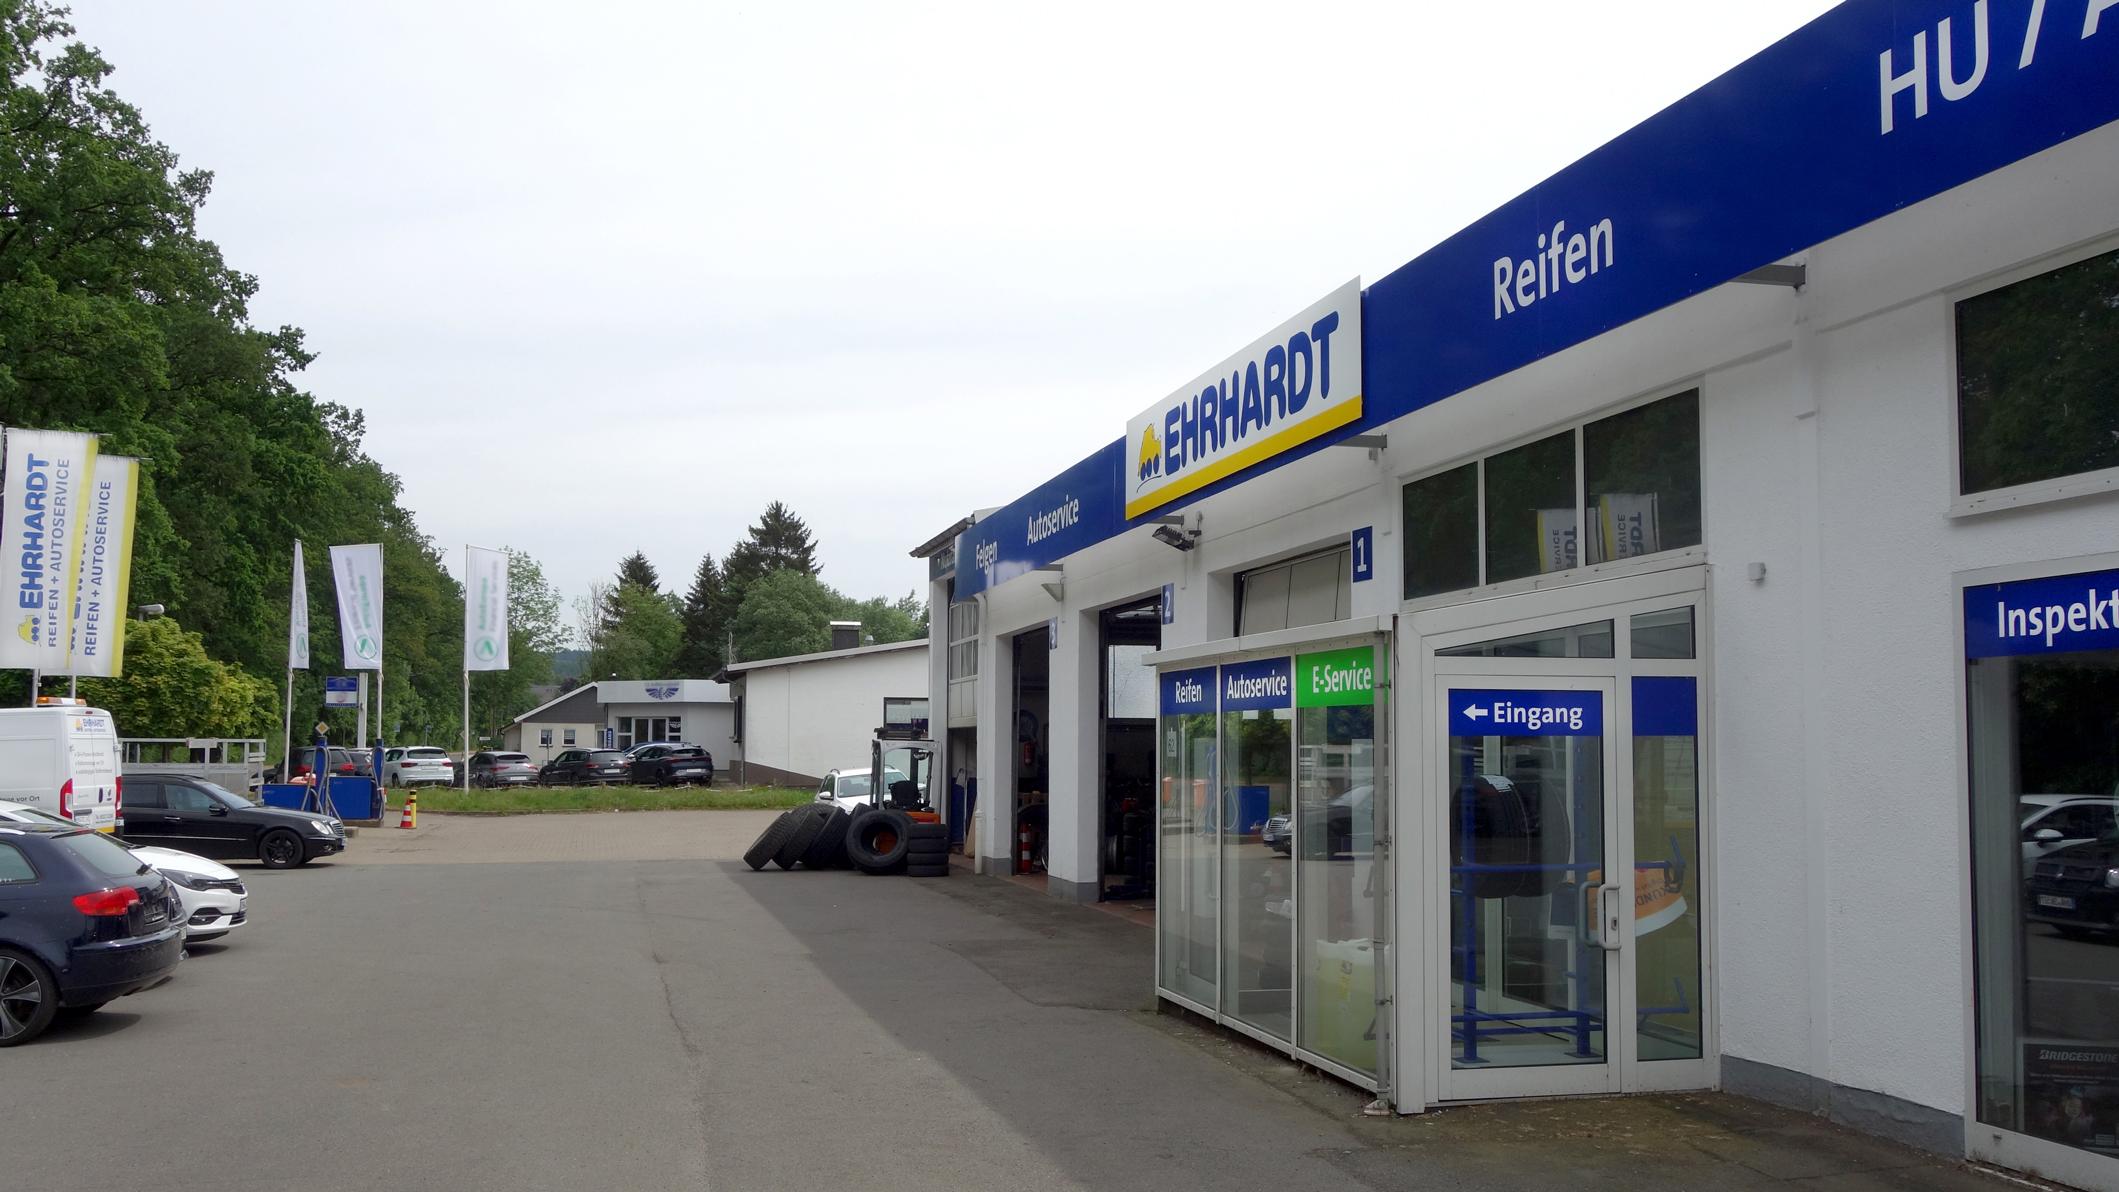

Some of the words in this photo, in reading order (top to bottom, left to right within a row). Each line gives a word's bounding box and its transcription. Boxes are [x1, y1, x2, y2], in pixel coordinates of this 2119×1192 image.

[1879, 0, 1989, 136] HU
[1493, 217, 1614, 321] Reifen
[1164, 310, 1339, 476] EHRHARDT
[19, 452, 50, 609] EHRHARDT
[49, 458, 70, 572] AUTOSERVICE
[1026, 494, 1080, 546] Autoservice
[90, 481, 112, 587] AUTOSERVICE
[975, 539, 998, 576] Felgen
[1356, 536, 1368, 573] 1
[50, 575, 60, 585] +
[91, 589, 101, 598] +
[48, 589, 60, 648] REIFEN
[1163, 591, 1171, 618] 2
[1998, 588, 2119, 647] Inspekt
[84, 601, 101, 656] REIFEN
[1050, 621, 1057, 646] 3
[1175, 678, 1202, 704] Reifen
[1226, 669, 1288, 700] Autoservice
[1312, 660, 1372, 694] E-Service
[1493, 701, 1584, 731] Eingang
[2039, 1049, 2119, 1063] BRIDGESTONE
